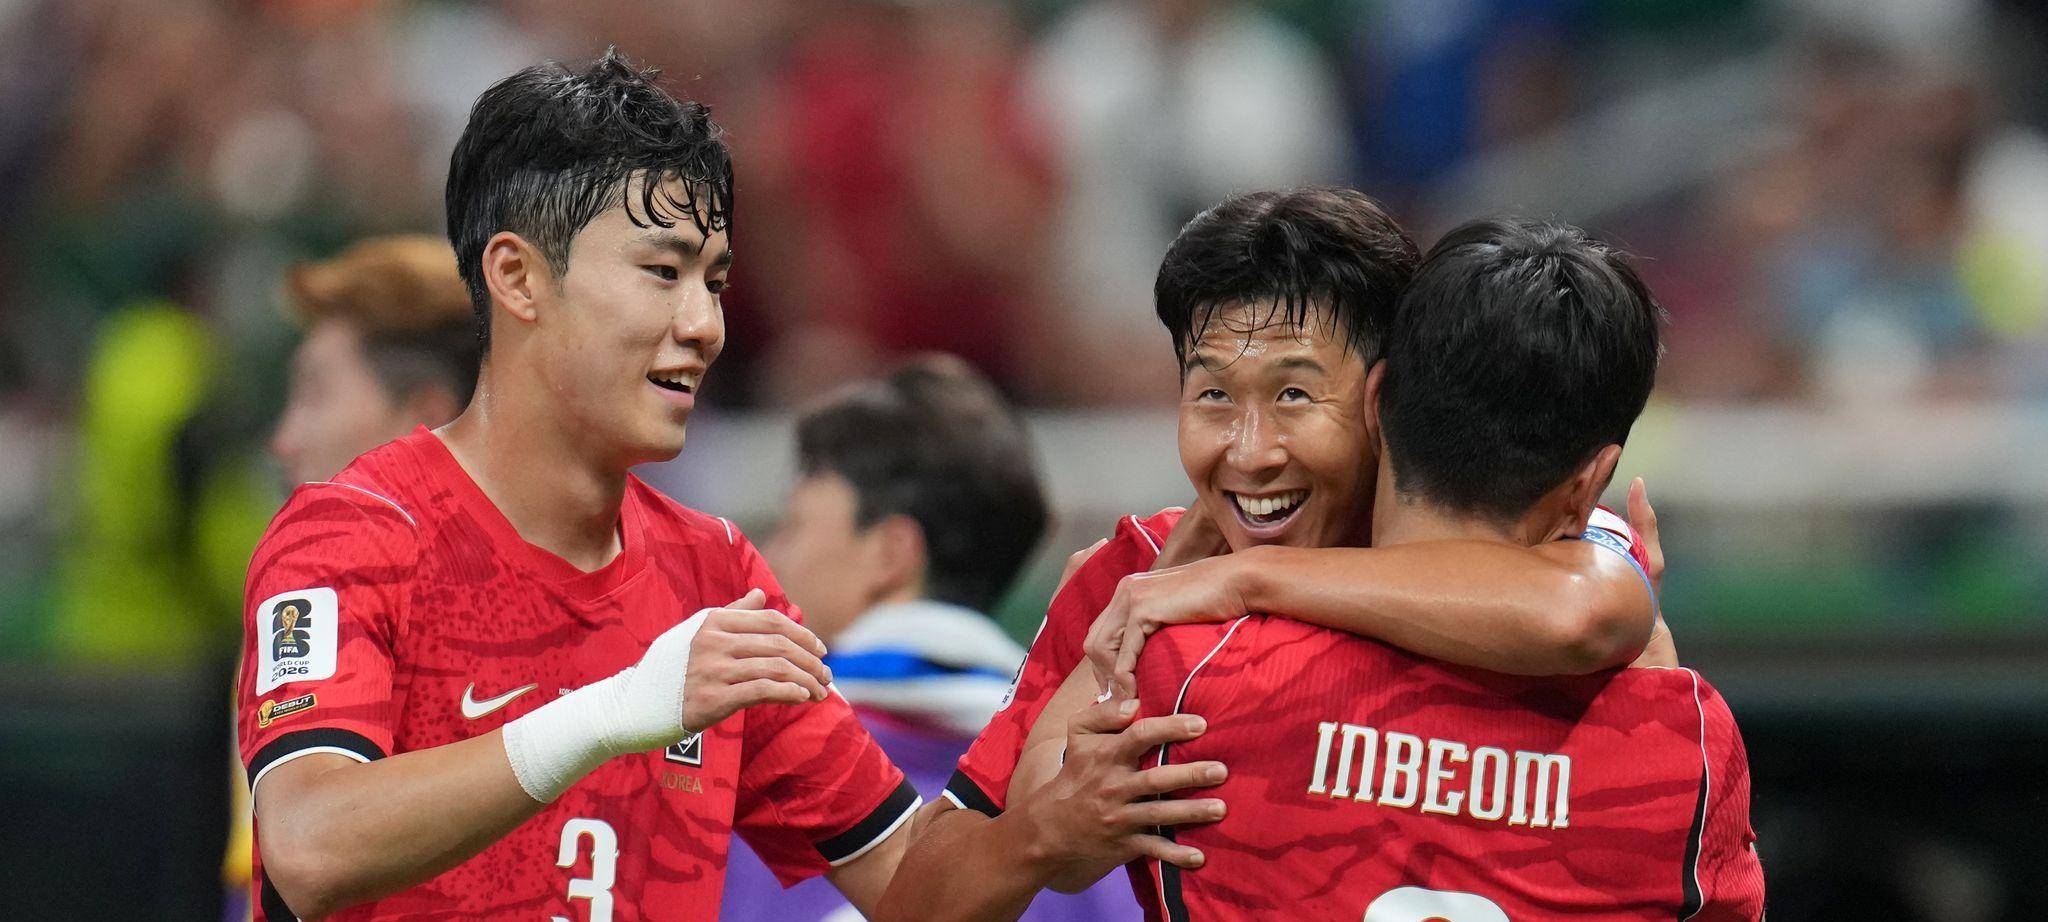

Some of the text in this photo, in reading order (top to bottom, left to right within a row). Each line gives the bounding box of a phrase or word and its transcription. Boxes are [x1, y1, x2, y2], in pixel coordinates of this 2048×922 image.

[279, 646, 299, 658] FIFA
[271, 666, 309, 682] 2026
[273, 696, 311, 712] DEBUT
[662, 770, 703, 794] KOREA
[1307, 721, 1572, 830] INBEOM
[555, 817, 620, 922] 3
